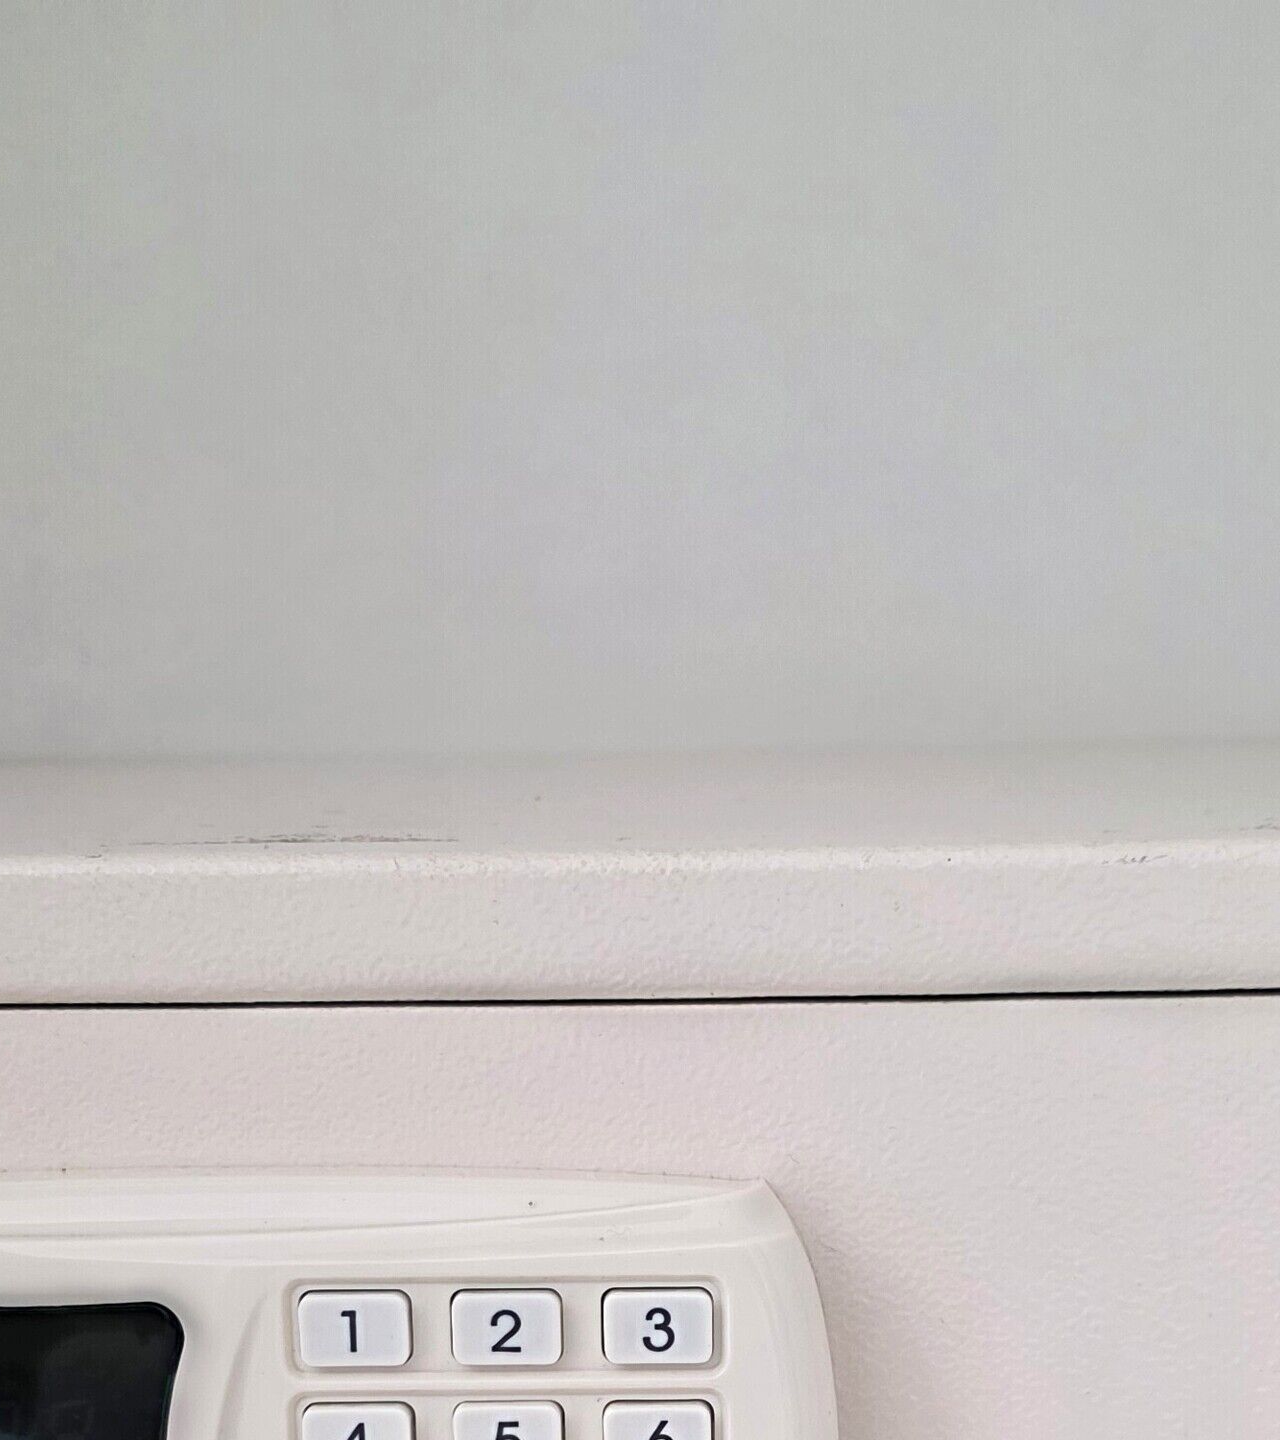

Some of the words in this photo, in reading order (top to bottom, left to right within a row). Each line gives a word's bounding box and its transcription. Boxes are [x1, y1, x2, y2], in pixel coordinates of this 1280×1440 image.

[340, 1310, 358, 1353] 1
[490, 1309, 522, 1353] 2
[642, 1307, 676, 1353] 3
